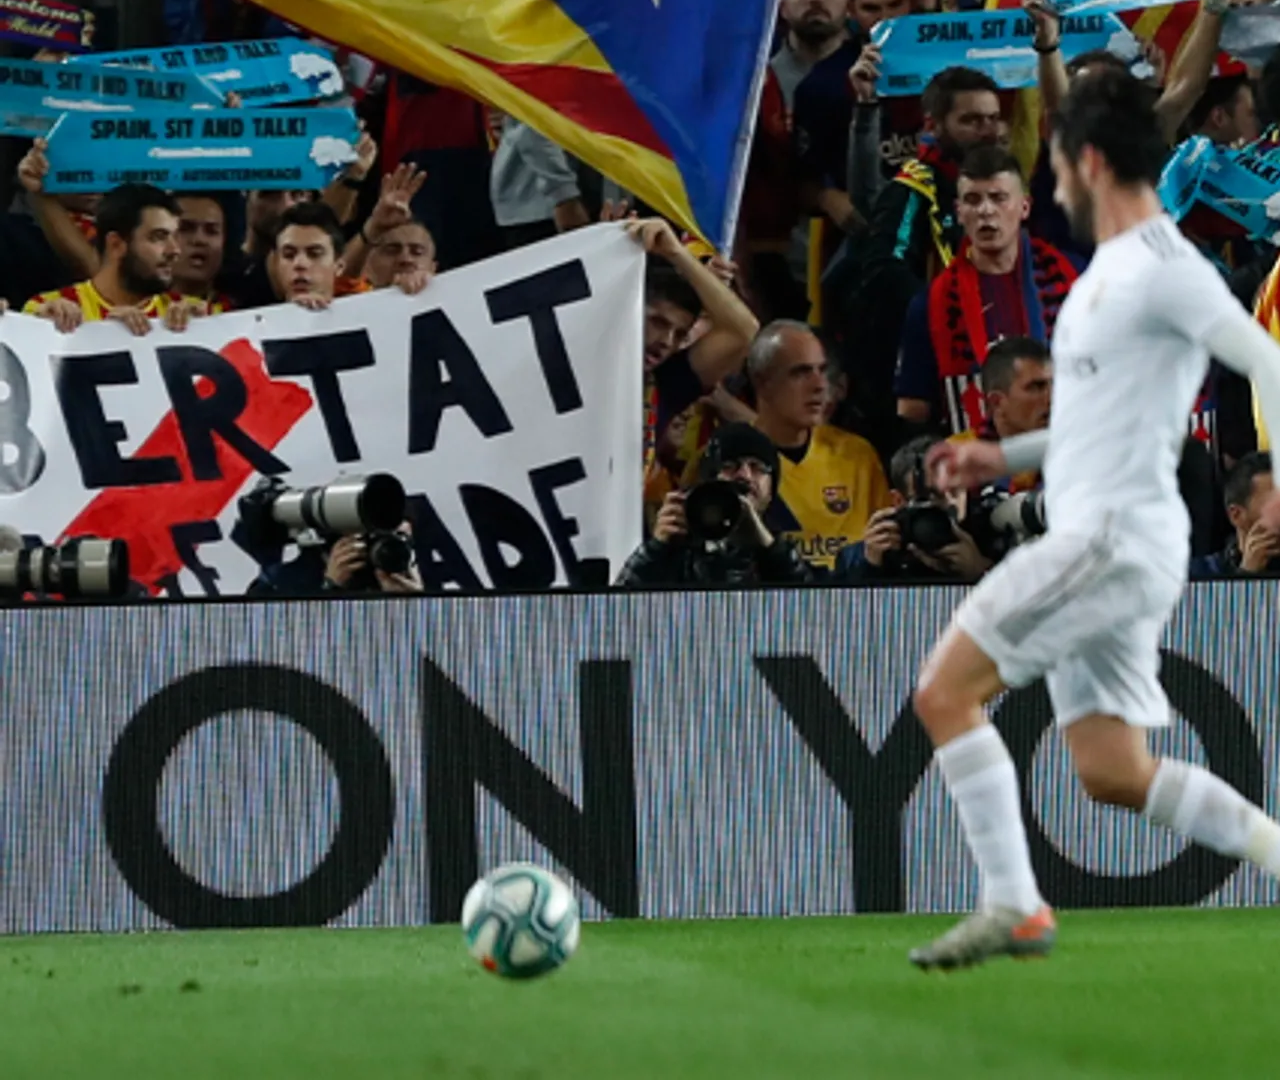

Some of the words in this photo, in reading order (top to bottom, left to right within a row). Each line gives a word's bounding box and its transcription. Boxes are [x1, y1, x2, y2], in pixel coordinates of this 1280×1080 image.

[916, 22, 975, 44] SPAIN,
[980, 20, 1005, 40] SIT
[1013, 19, 1039, 37] AN
[90, 119, 157, 140] SPAIN,
[165, 118, 192, 138] SIT
[203, 118, 243, 138] AND
[254, 117, 306, 137] TALK!
[101, 654, 641, 929] ON
